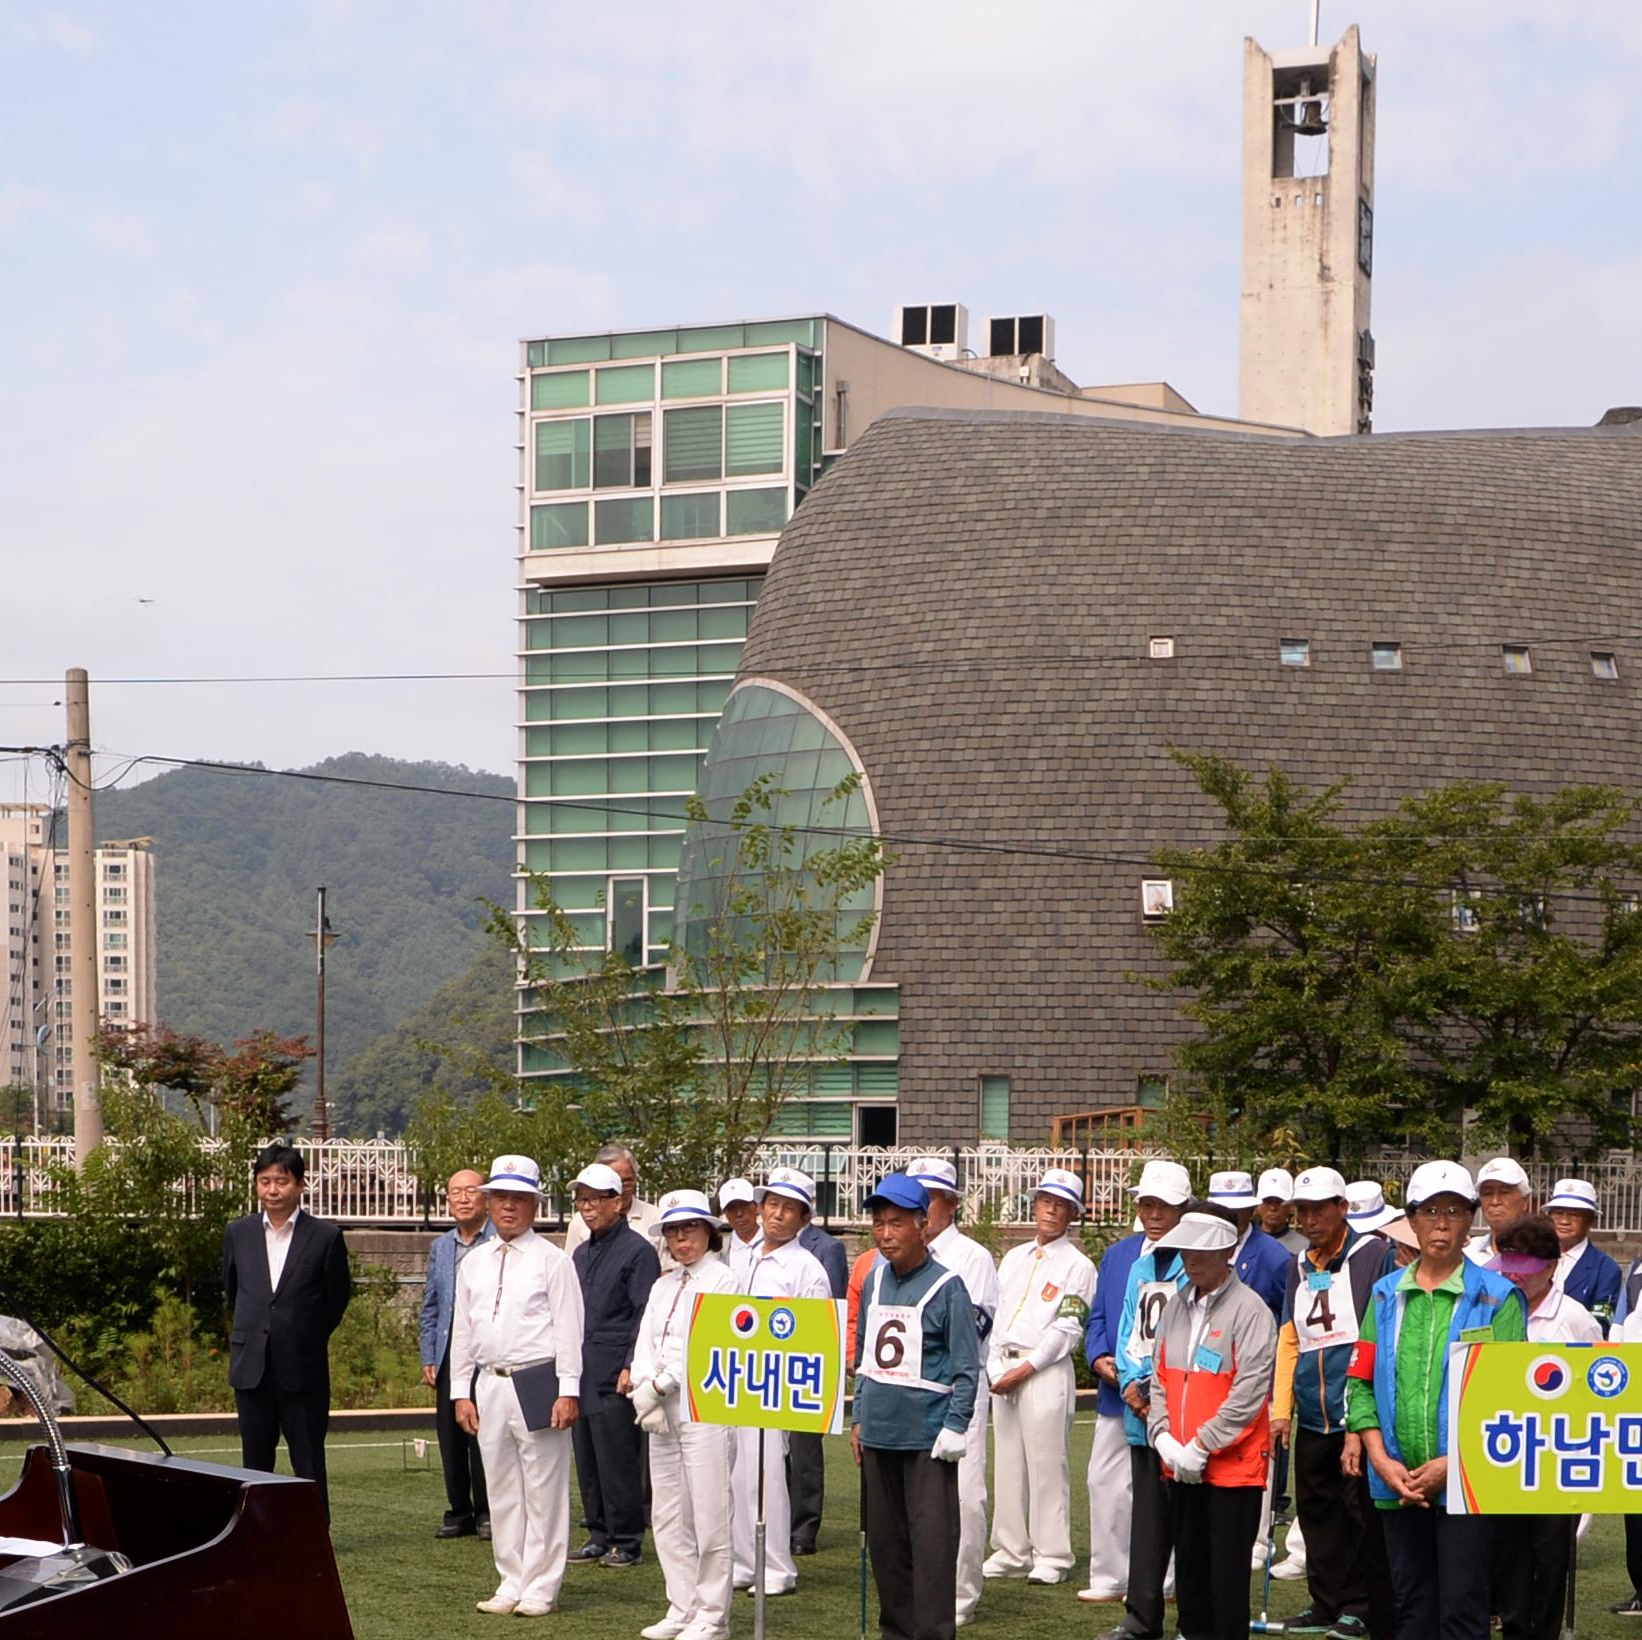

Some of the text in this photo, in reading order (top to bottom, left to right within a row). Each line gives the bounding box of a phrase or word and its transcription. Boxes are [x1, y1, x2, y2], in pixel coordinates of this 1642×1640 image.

[1139, 1291, 1167, 1341] 10
[1306, 1289, 1336, 1332] 4
[874, 1319, 906, 1369] 6
[704, 1349, 823, 1411] 사내면
